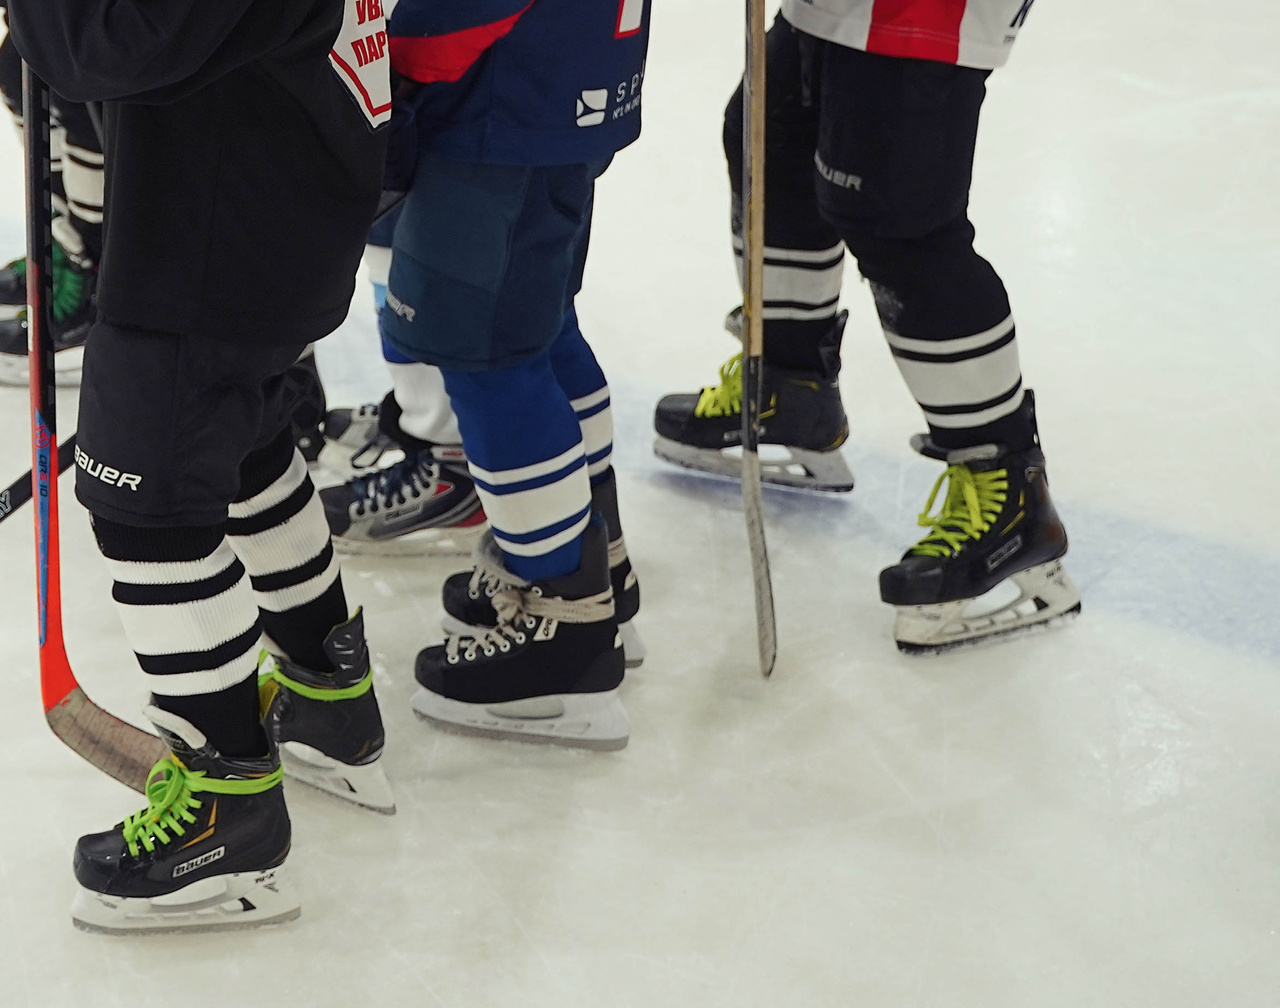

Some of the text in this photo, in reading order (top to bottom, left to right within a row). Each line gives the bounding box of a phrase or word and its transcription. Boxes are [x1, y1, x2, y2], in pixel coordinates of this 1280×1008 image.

[350, 28, 387, 68] ПАР
[74, 444, 143, 491] BAUER
[174, 848, 224, 877] BAUER
